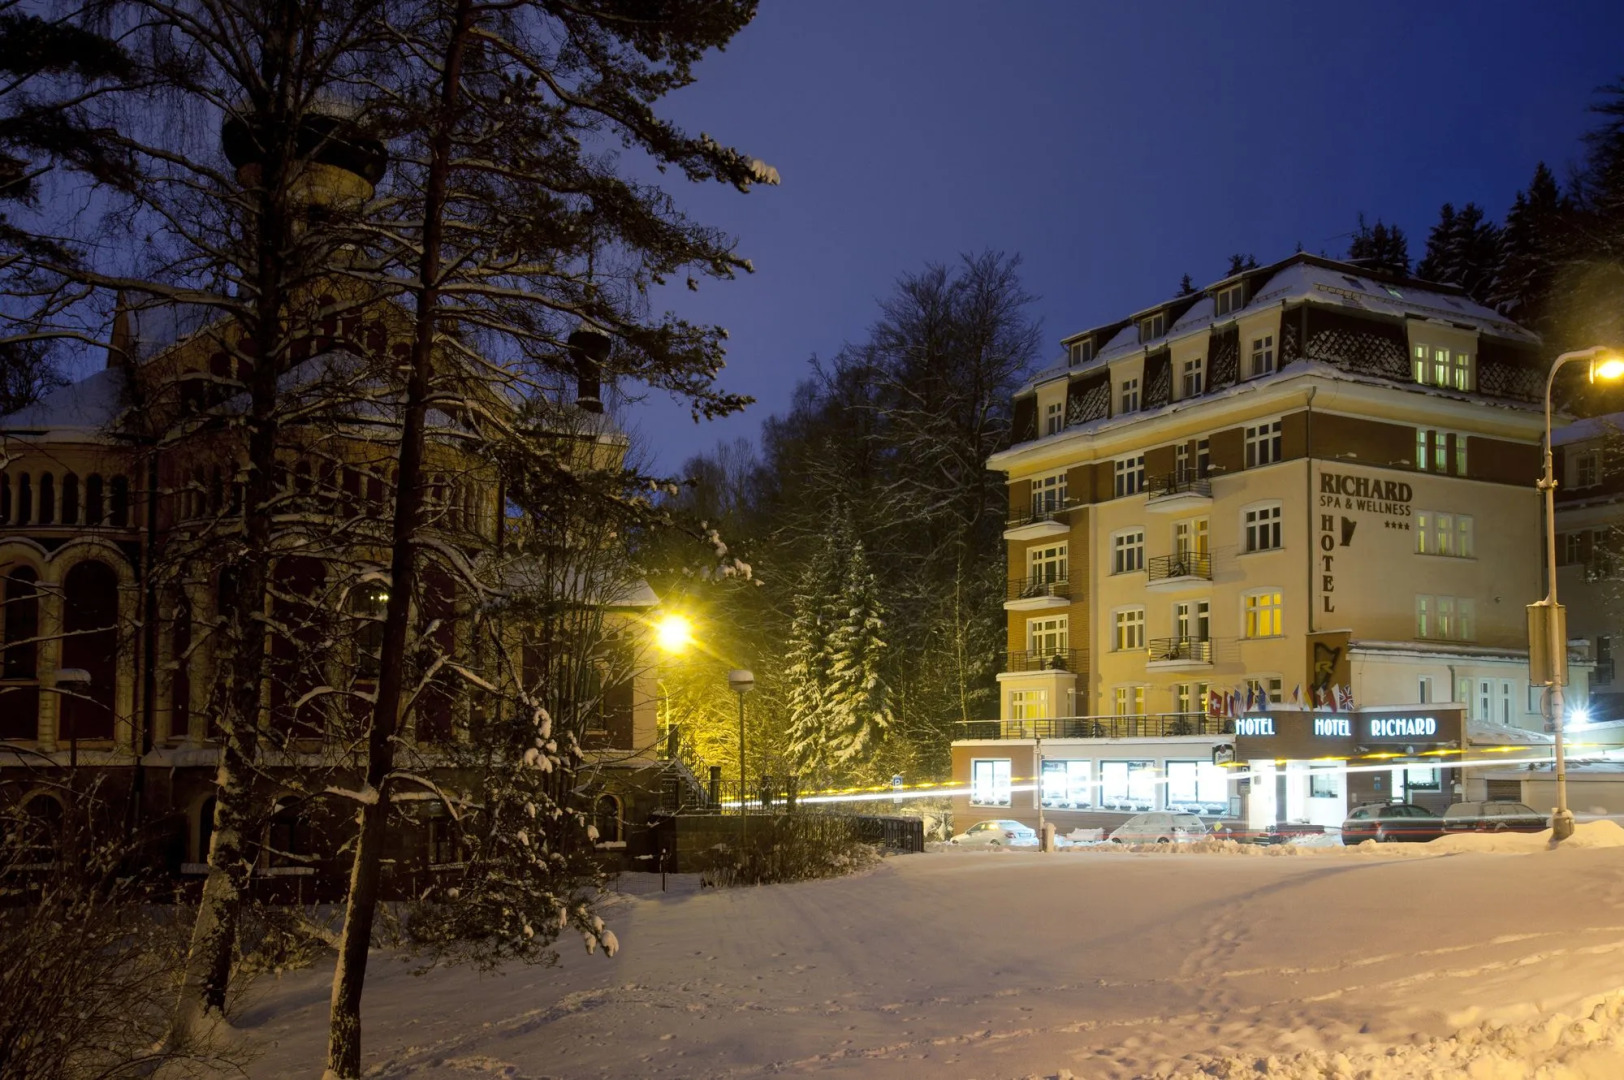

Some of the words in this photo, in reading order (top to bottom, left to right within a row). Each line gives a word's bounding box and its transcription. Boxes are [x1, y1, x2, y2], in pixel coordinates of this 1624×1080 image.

[1320, 473, 1413, 503] RICHARD
[1320, 495, 1341, 509] SPA
[1345, 498, 1352, 510] &
[1356, 499, 1411, 517] WELLNESS
[1320, 514, 1335, 613] HOTEL
[1235, 718, 1275, 736] HOTEL
[1315, 718, 1351, 736] HOTEL
[1371, 717, 1436, 737] RICHARD
